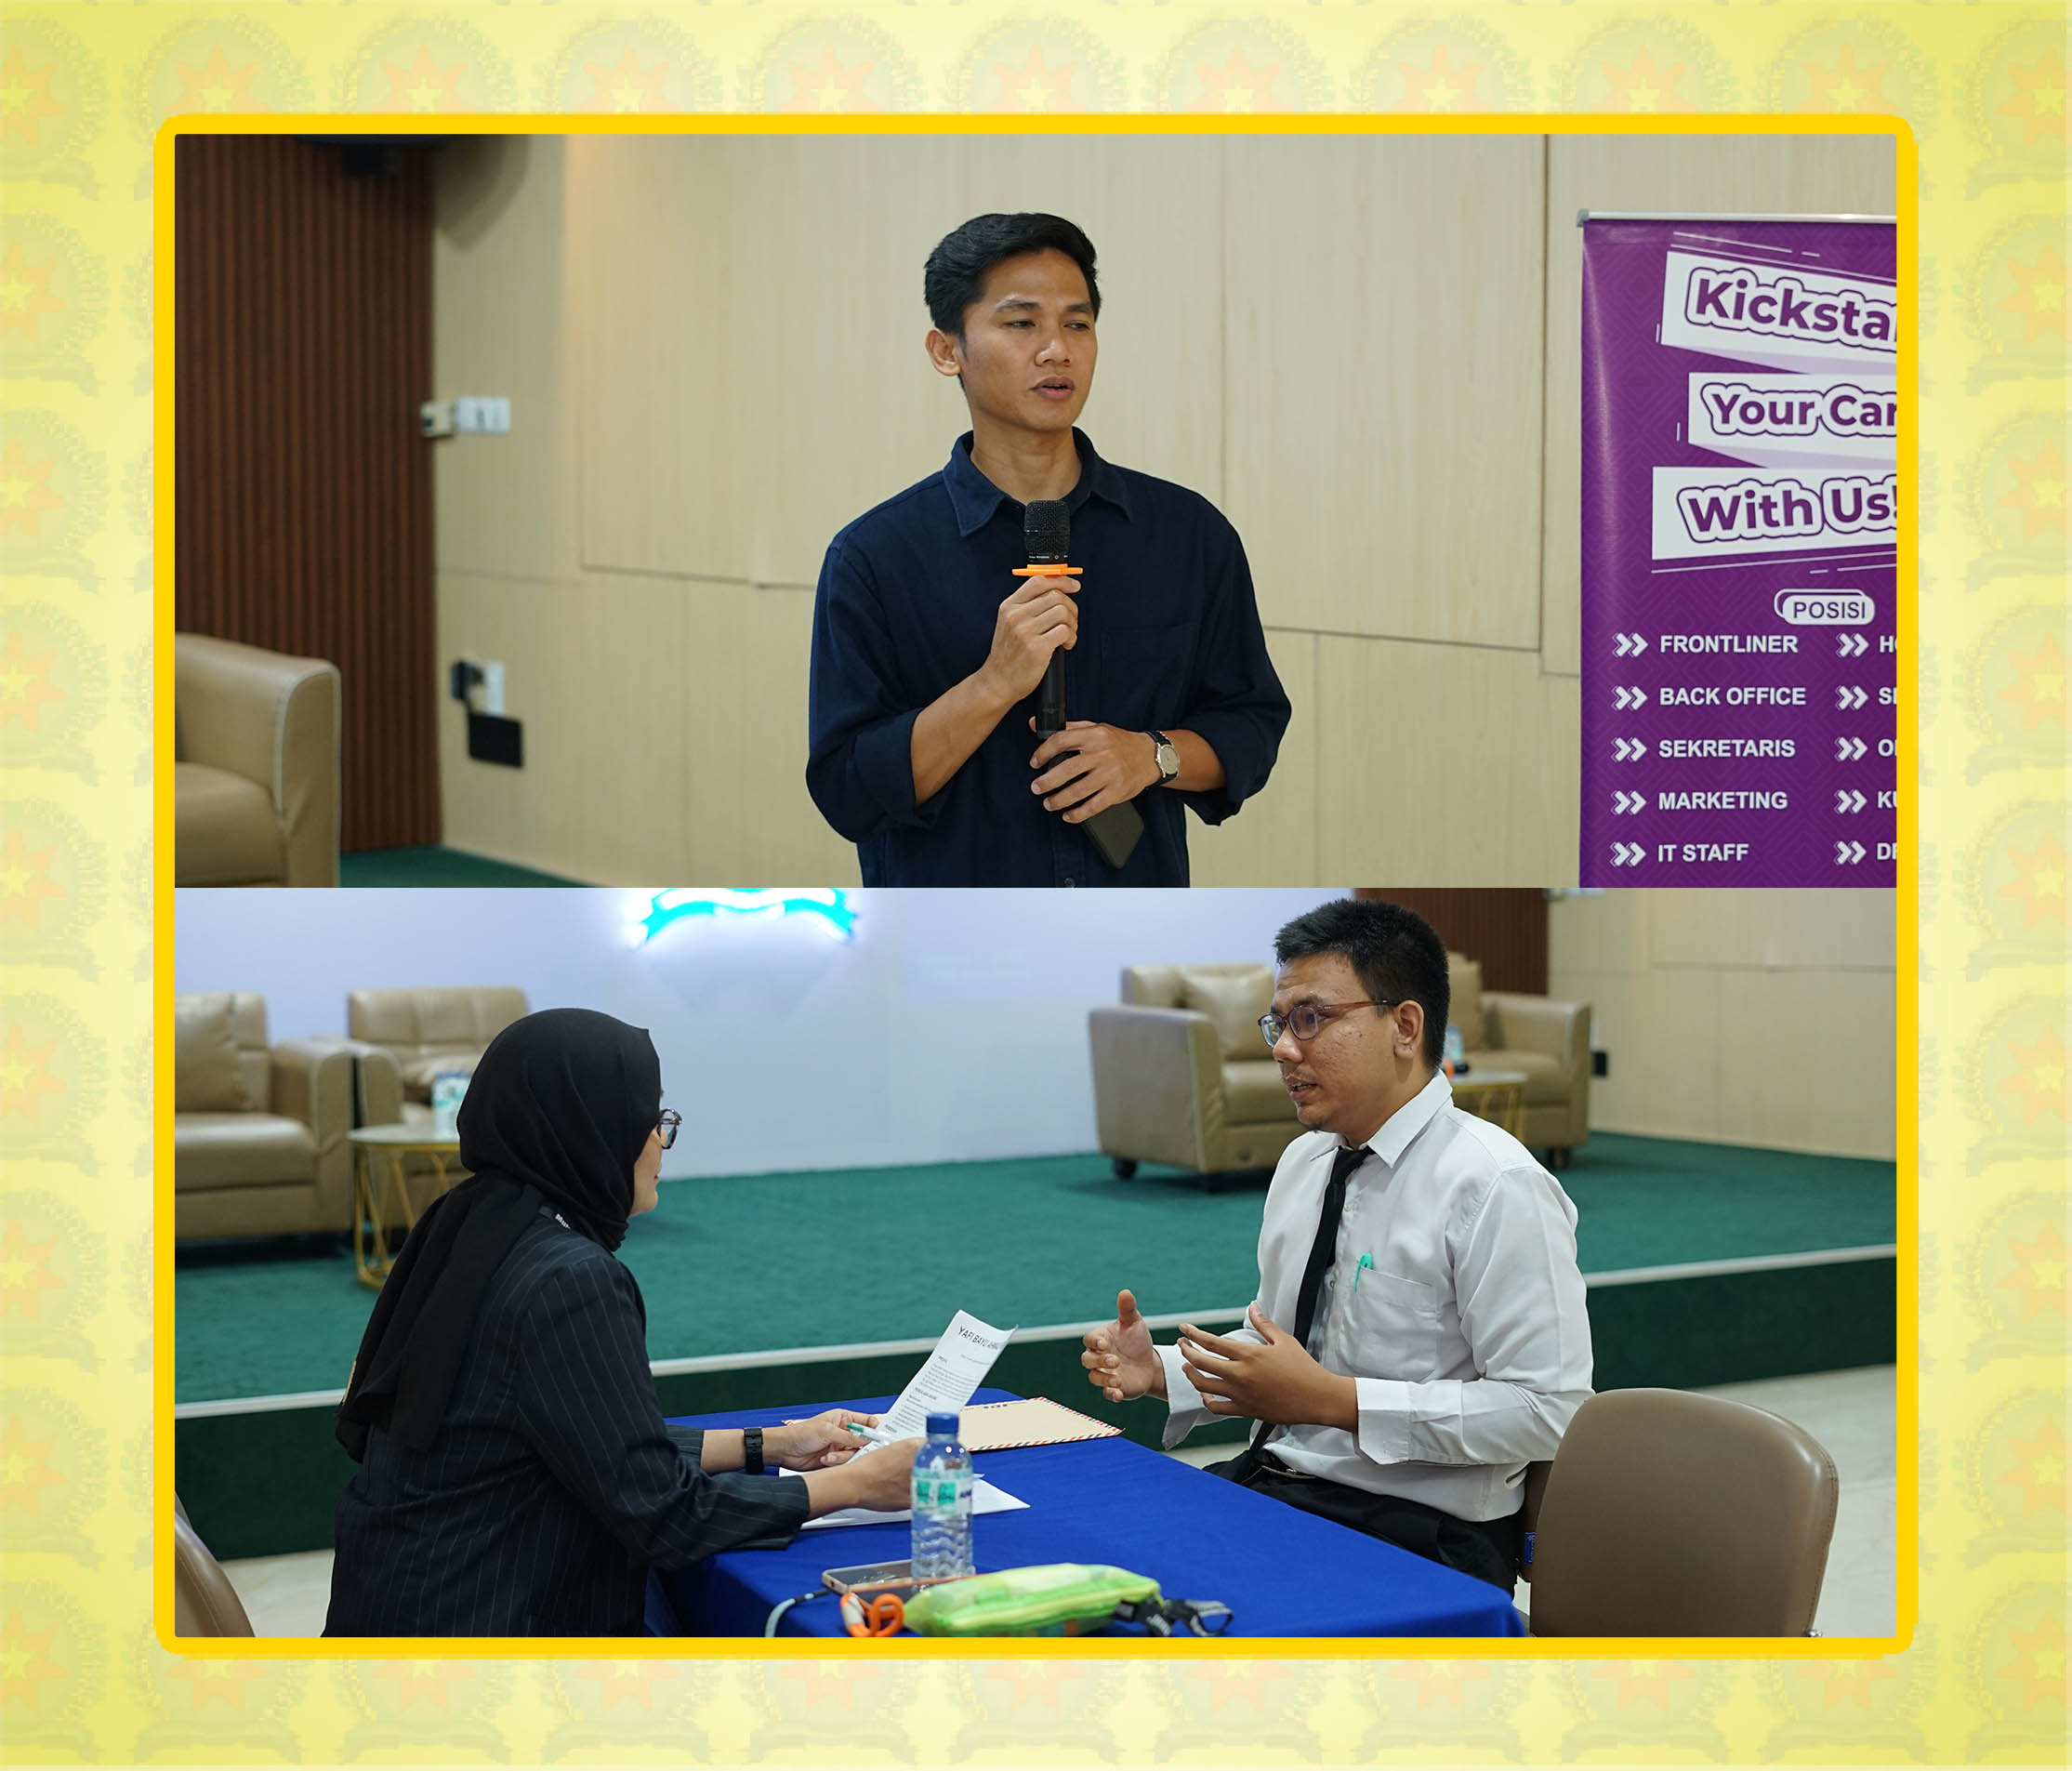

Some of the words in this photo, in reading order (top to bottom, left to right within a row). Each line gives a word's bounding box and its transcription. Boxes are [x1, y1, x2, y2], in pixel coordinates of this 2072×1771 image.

[1696, 278, 1896, 342] Kicksta
[1712, 393, 1815, 425] Your
[1687, 490, 1814, 533] With
[1793, 601, 1866, 619] POSISI
[1660, 635, 1799, 654] FRONTLINER
[1880, 635, 1896, 654] H
[1659, 687, 1721, 706] BACK
[1726, 687, 1806, 706] OFFICE
[1659, 740, 1796, 758] SEKRETARIS
[1879, 739, 1896, 757] O
[1658, 792, 1788, 811] MARKETING
[1658, 844, 1677, 863] IT
[1683, 843, 1749, 863] STAFF
